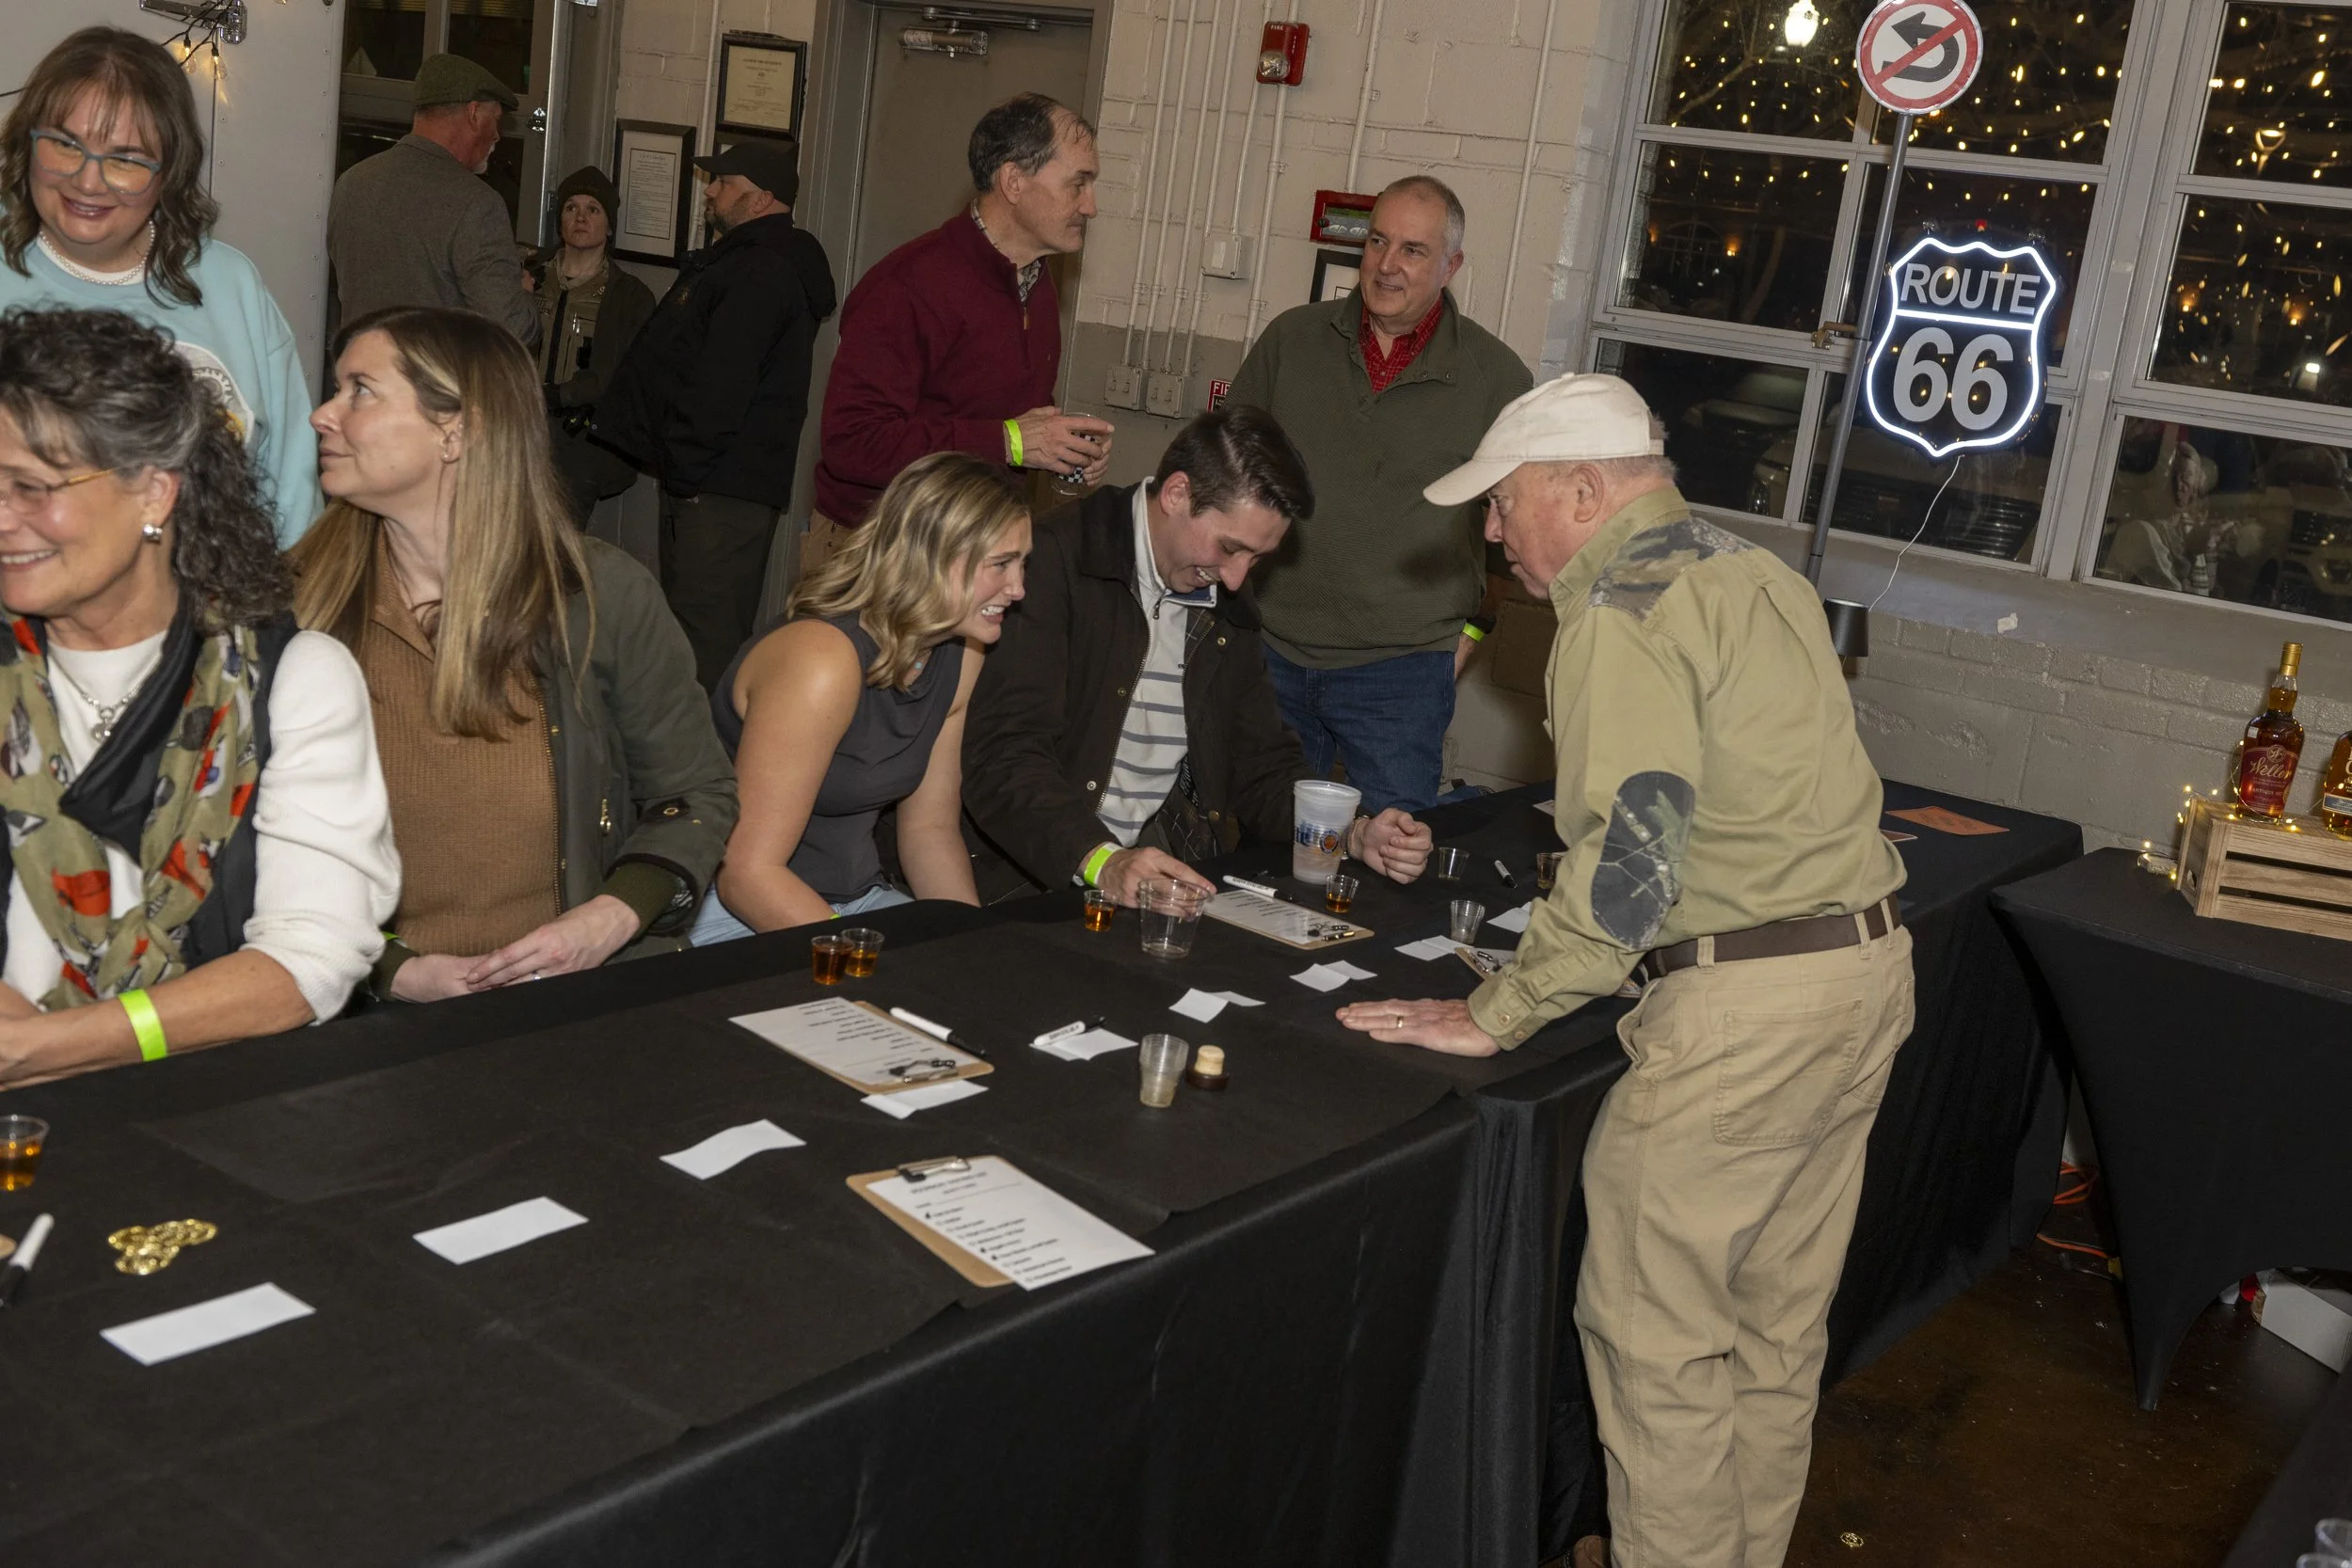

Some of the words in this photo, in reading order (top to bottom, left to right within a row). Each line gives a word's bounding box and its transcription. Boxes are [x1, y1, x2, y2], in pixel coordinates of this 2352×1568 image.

[1899, 262, 2041, 316] ROUTE
[1893, 326, 2014, 432] 66
[2249, 756, 2292, 779] Weller
